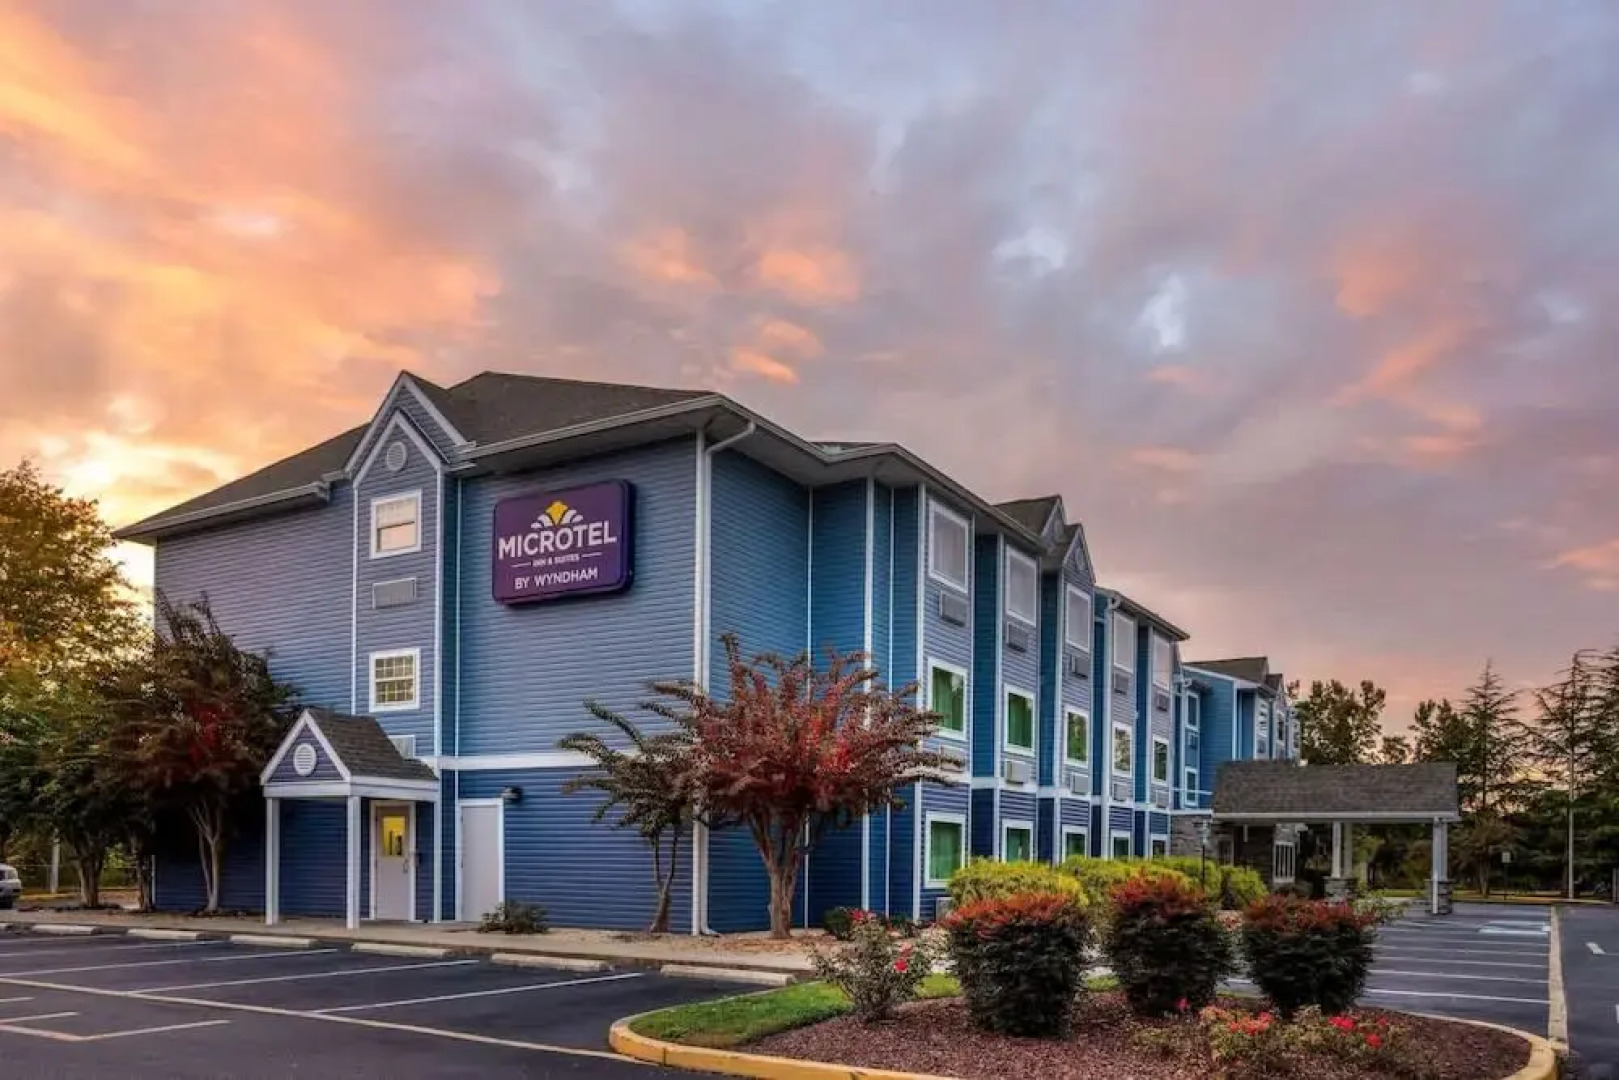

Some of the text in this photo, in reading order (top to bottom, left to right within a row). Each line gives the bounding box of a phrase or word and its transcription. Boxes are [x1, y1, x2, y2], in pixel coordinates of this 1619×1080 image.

[498, 520, 618, 560] MICROTEL
[514, 567, 599, 590] BY WYNDHAM
